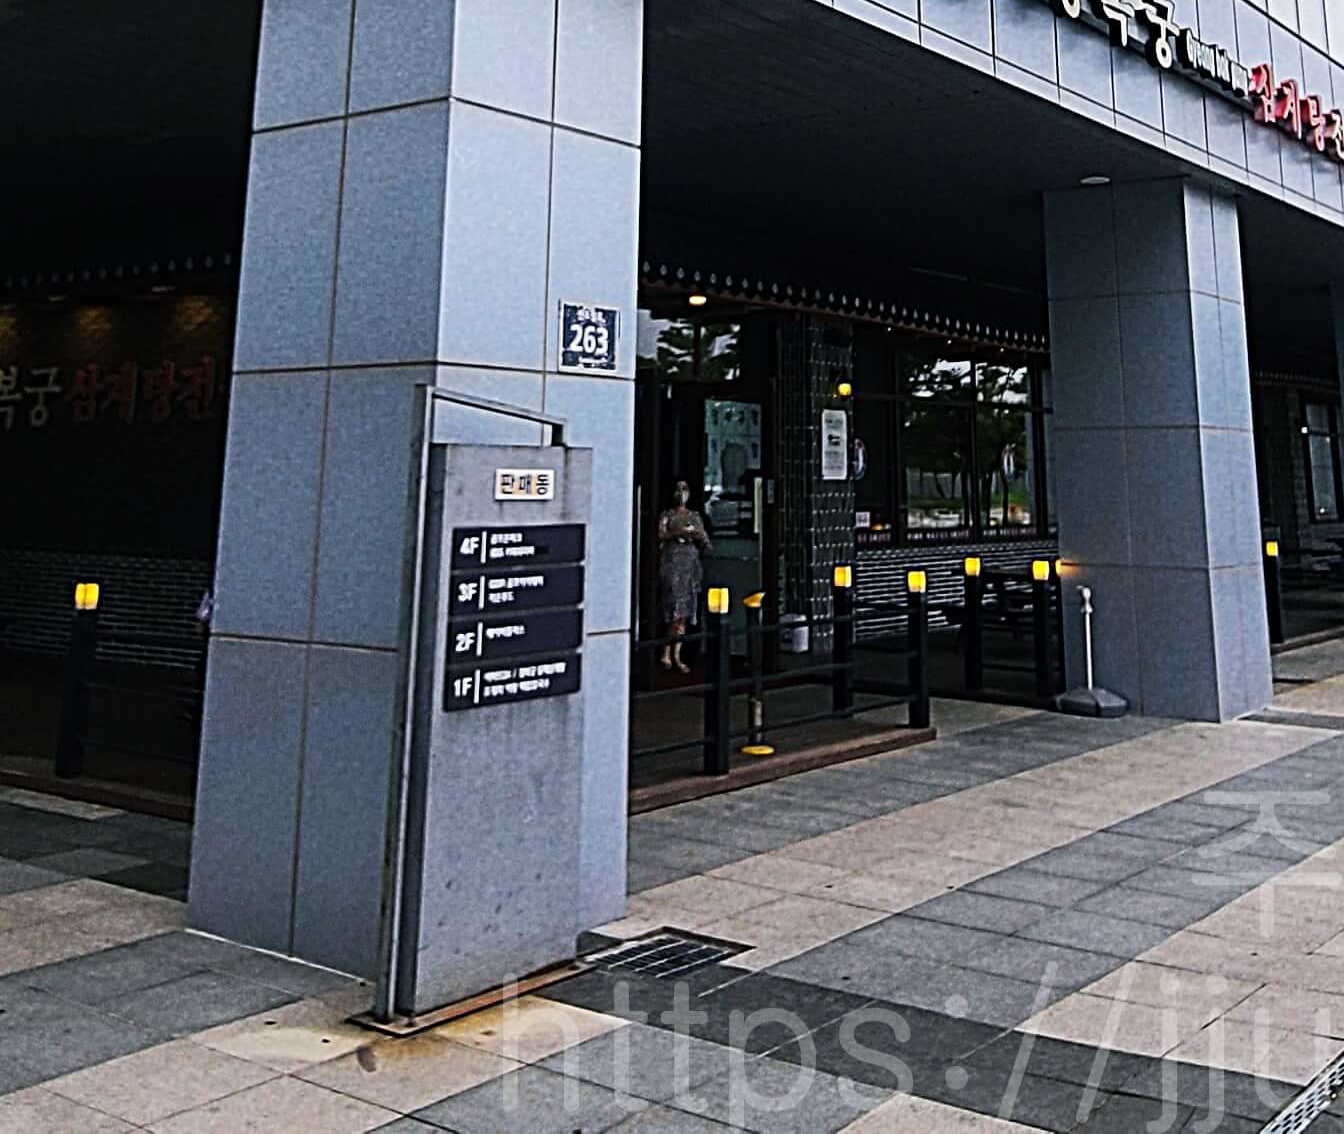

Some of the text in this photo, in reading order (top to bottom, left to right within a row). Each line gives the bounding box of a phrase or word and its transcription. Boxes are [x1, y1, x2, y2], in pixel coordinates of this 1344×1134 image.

[569, 323, 609, 356] 263
[500, 474, 550, 496] 판매동
[459, 536, 480, 555] 4F
[458, 582, 478, 602] 3F
[455, 631, 476, 652] 2F
[454, 676, 473, 697] 1F
